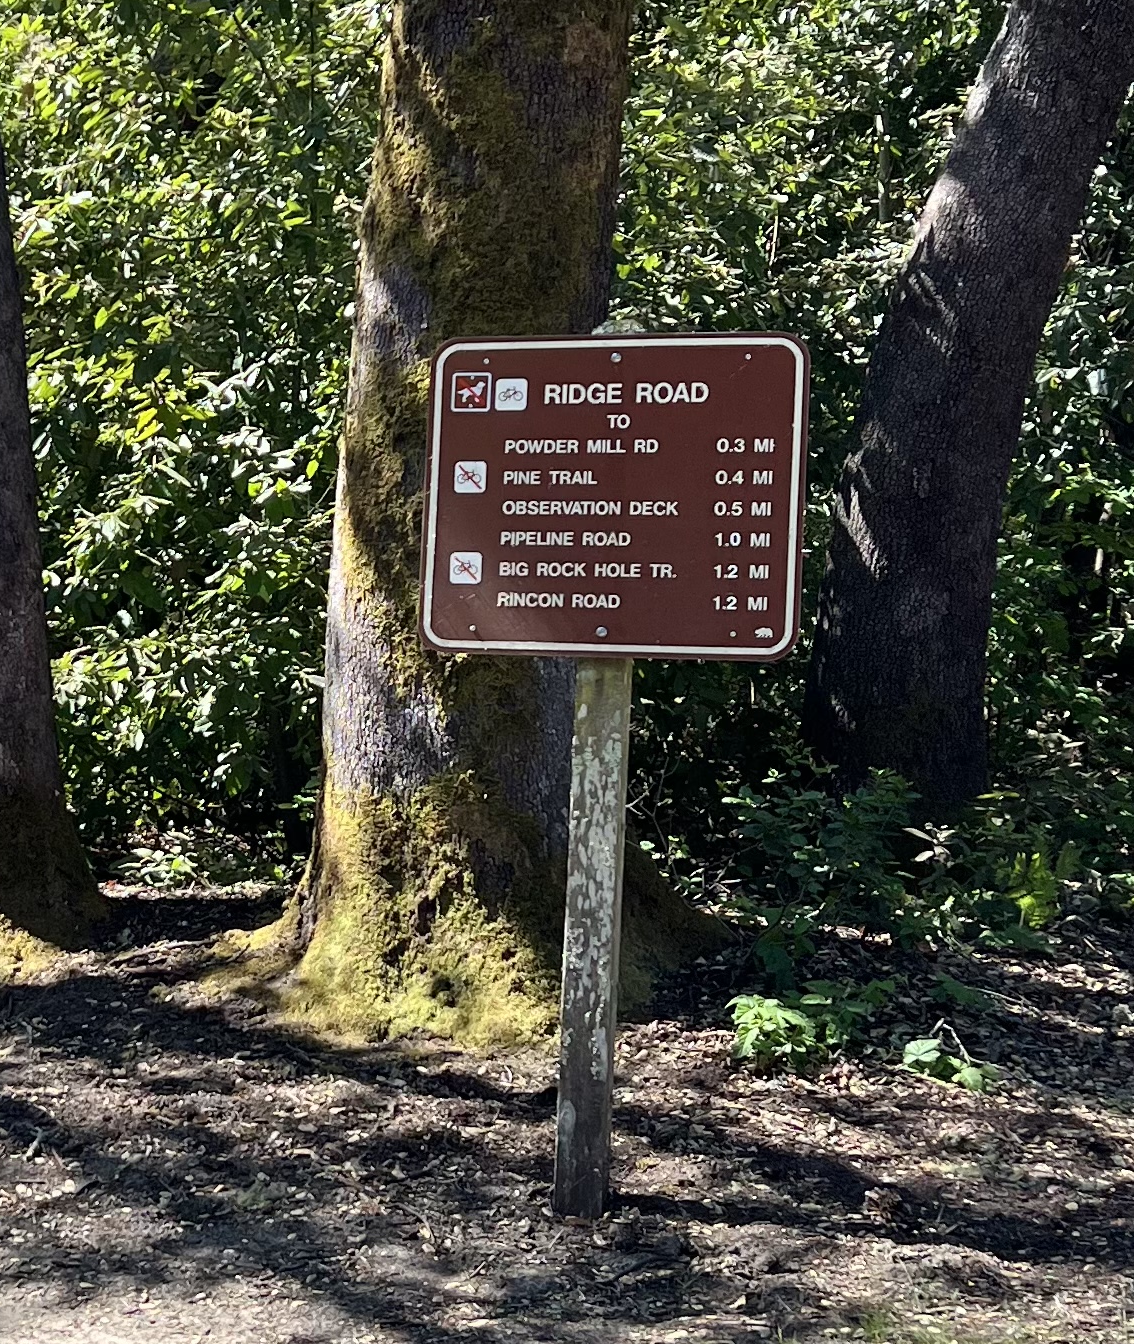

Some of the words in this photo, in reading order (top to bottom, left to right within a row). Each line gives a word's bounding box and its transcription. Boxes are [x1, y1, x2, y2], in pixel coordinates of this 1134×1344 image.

[543, 382, 623, 405] RIDGE
[635, 381, 710, 404] ROAD
[606, 413, 631, 429] TO
[504, 439, 579, 454] POWDER
[586, 439, 627, 454] MILL
[633, 438, 659, 454] RD
[716, 437, 746, 453] 0.3
[753, 438, 776, 453] MI
[503, 470, 542, 485] PINE
[548, 470, 598, 485] TRAIL
[715, 469, 745, 485] 0.4
[752, 470, 774, 485] MI
[501, 500, 622, 516] OBSERVATION
[629, 500, 679, 516] DECK
[713, 501, 743, 517] 0.5
[750, 501, 772, 517] MI
[499, 531, 575, 547] PIPELINE
[581, 531, 631, 547] ROAD
[714, 532, 742, 547] 1.0
[749, 532, 771, 548] MI
[498, 561, 529, 577] BIG
[536, 562, 587, 577] ROCK
[594, 562, 642, 578] HOLE
[649, 563, 678, 579] TR.
[713, 564, 739, 579] 1.2
[748, 564, 770, 580] MI
[495, 591, 565, 608] RINCON
[571, 593, 621, 609] ROAD
[712, 595, 738, 611] 1.2
[747, 596, 768, 611] MI
